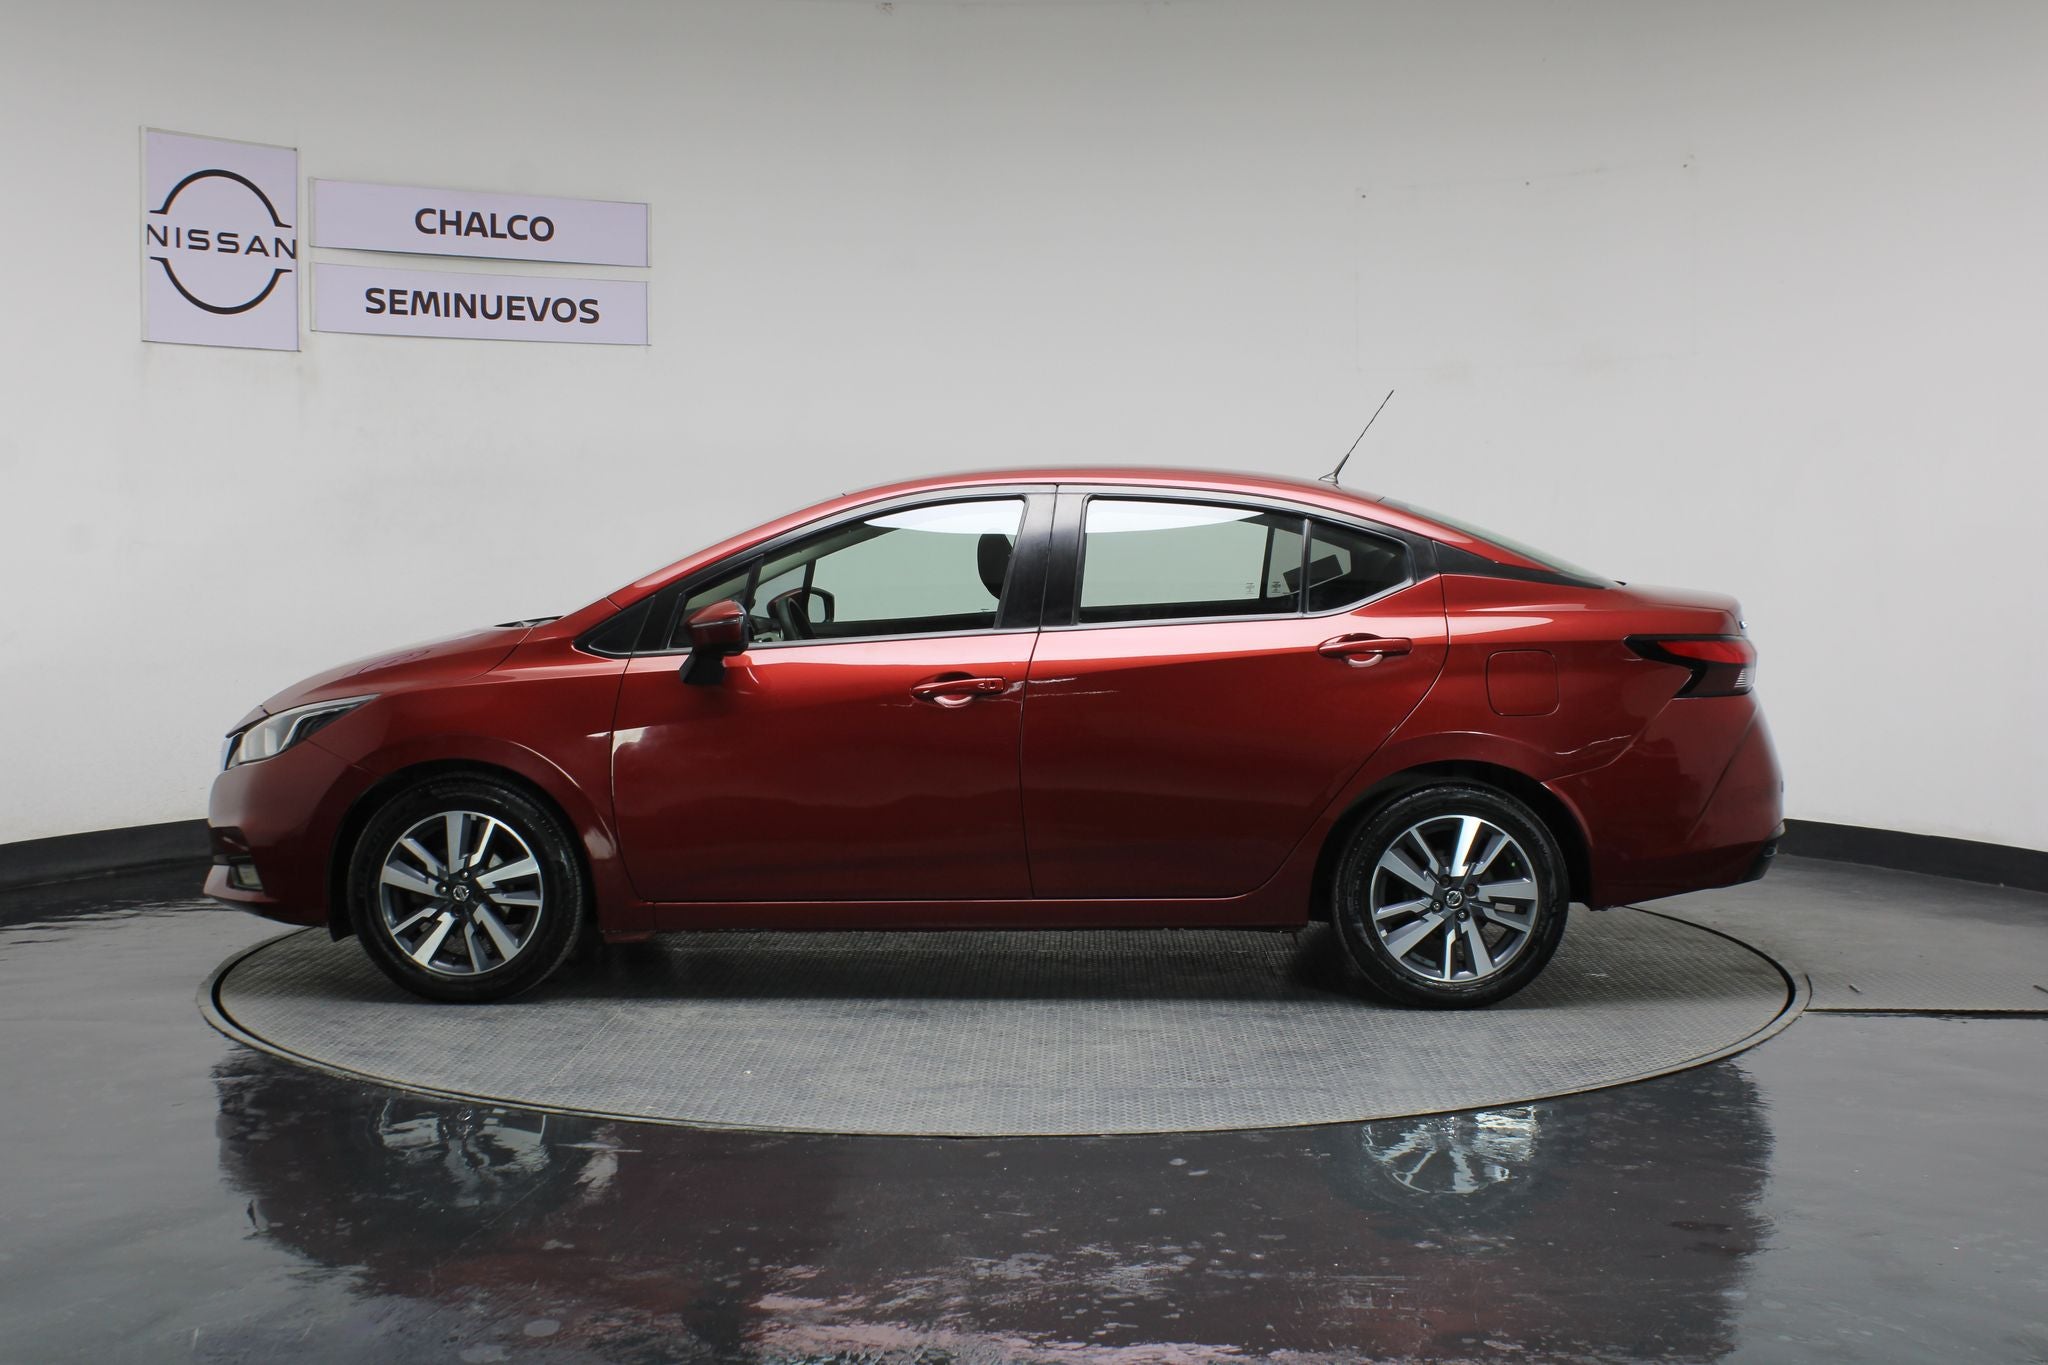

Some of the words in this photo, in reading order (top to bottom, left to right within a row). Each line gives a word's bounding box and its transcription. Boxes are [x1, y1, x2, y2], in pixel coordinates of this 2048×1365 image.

[147, 224, 297, 259] NISSAN
[415, 208, 555, 242] CHALCO
[365, 287, 600, 324] SEMINUEVOS
